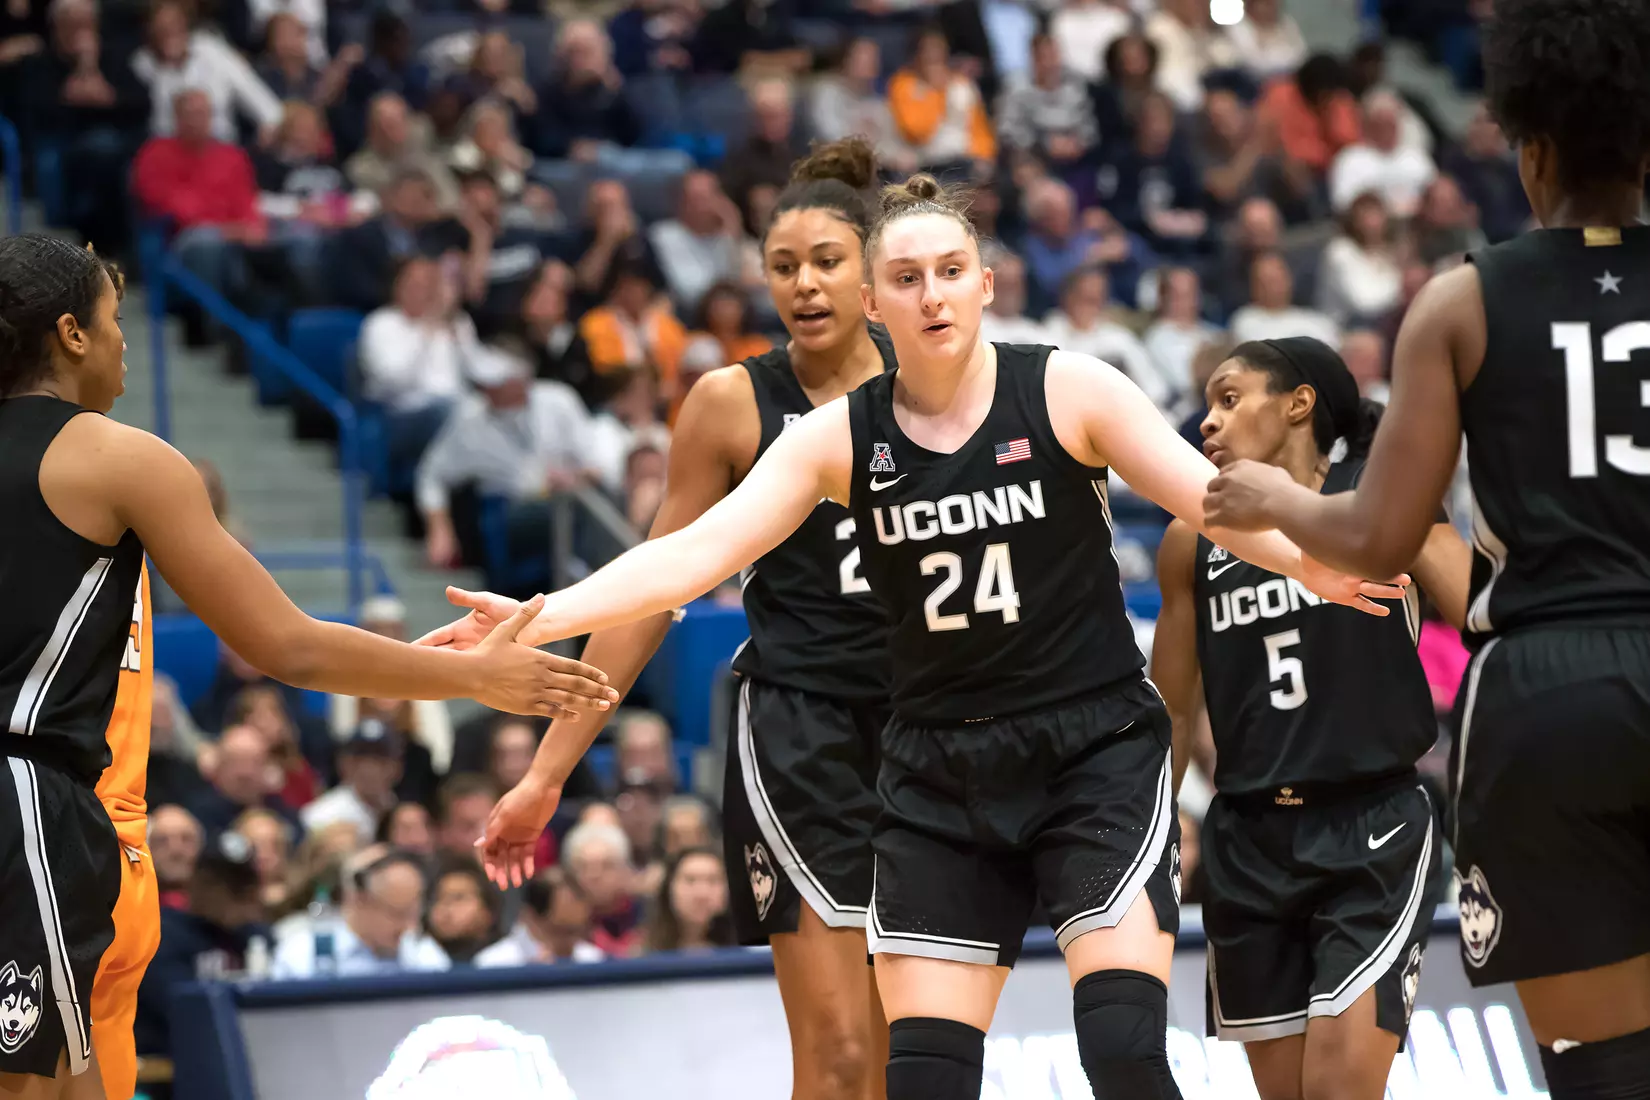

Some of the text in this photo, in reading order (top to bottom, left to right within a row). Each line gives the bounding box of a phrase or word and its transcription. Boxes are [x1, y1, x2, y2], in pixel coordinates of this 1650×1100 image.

[1550, 320, 1650, 478] 13
[872, 480, 1046, 545] UCONN
[919, 542, 1021, 633] 24
[1209, 576, 1331, 633] UCON
[1263, 628, 1309, 711] 5
